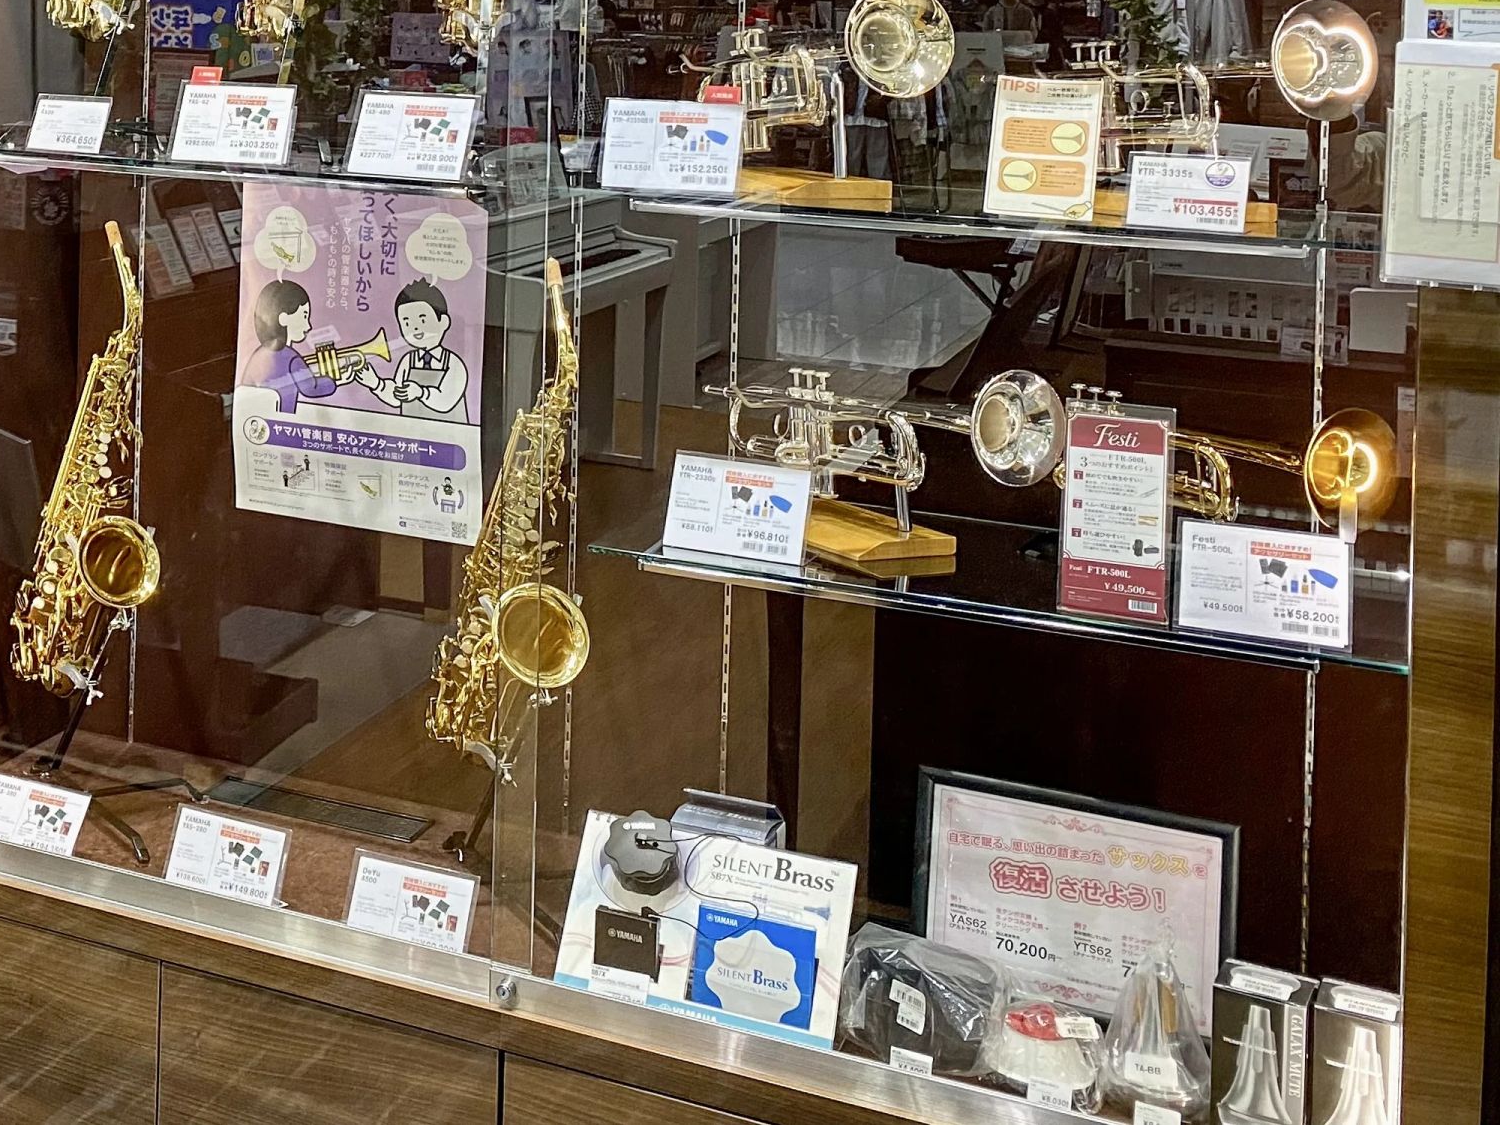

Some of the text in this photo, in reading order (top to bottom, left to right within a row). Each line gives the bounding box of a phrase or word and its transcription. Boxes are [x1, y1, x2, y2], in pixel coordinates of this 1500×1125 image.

[1001, 78, 1040, 94] TIPS!
[613, 109, 646, 117] YAMAHA
[355, 190, 376, 312] ってほしいから
[273, 424, 437, 456] ヤマハ管楽器 安心アフターサポート
[1093, 423, 1140, 448] Festi
[680, 464, 713, 474] YAMAHA
[1192, 534, 1215, 544] Festi
[1087, 565, 1131, 579] FTR-500L
[185, 815, 211, 827] YAMAHA
[630, 821, 656, 832] YAMAHA
[710, 872, 735, 883] SB7X
[712, 854, 835, 893] SILENT Brass
[989, 857, 1053, 898] 復活
[713, 914, 739, 928] YAMAHA
[950, 913, 987, 930] YAS62
[616, 929, 643, 944] YAMAHA
[1073, 941, 1112, 958] YTS62
[717, 965, 788, 992] SILENT Brass
